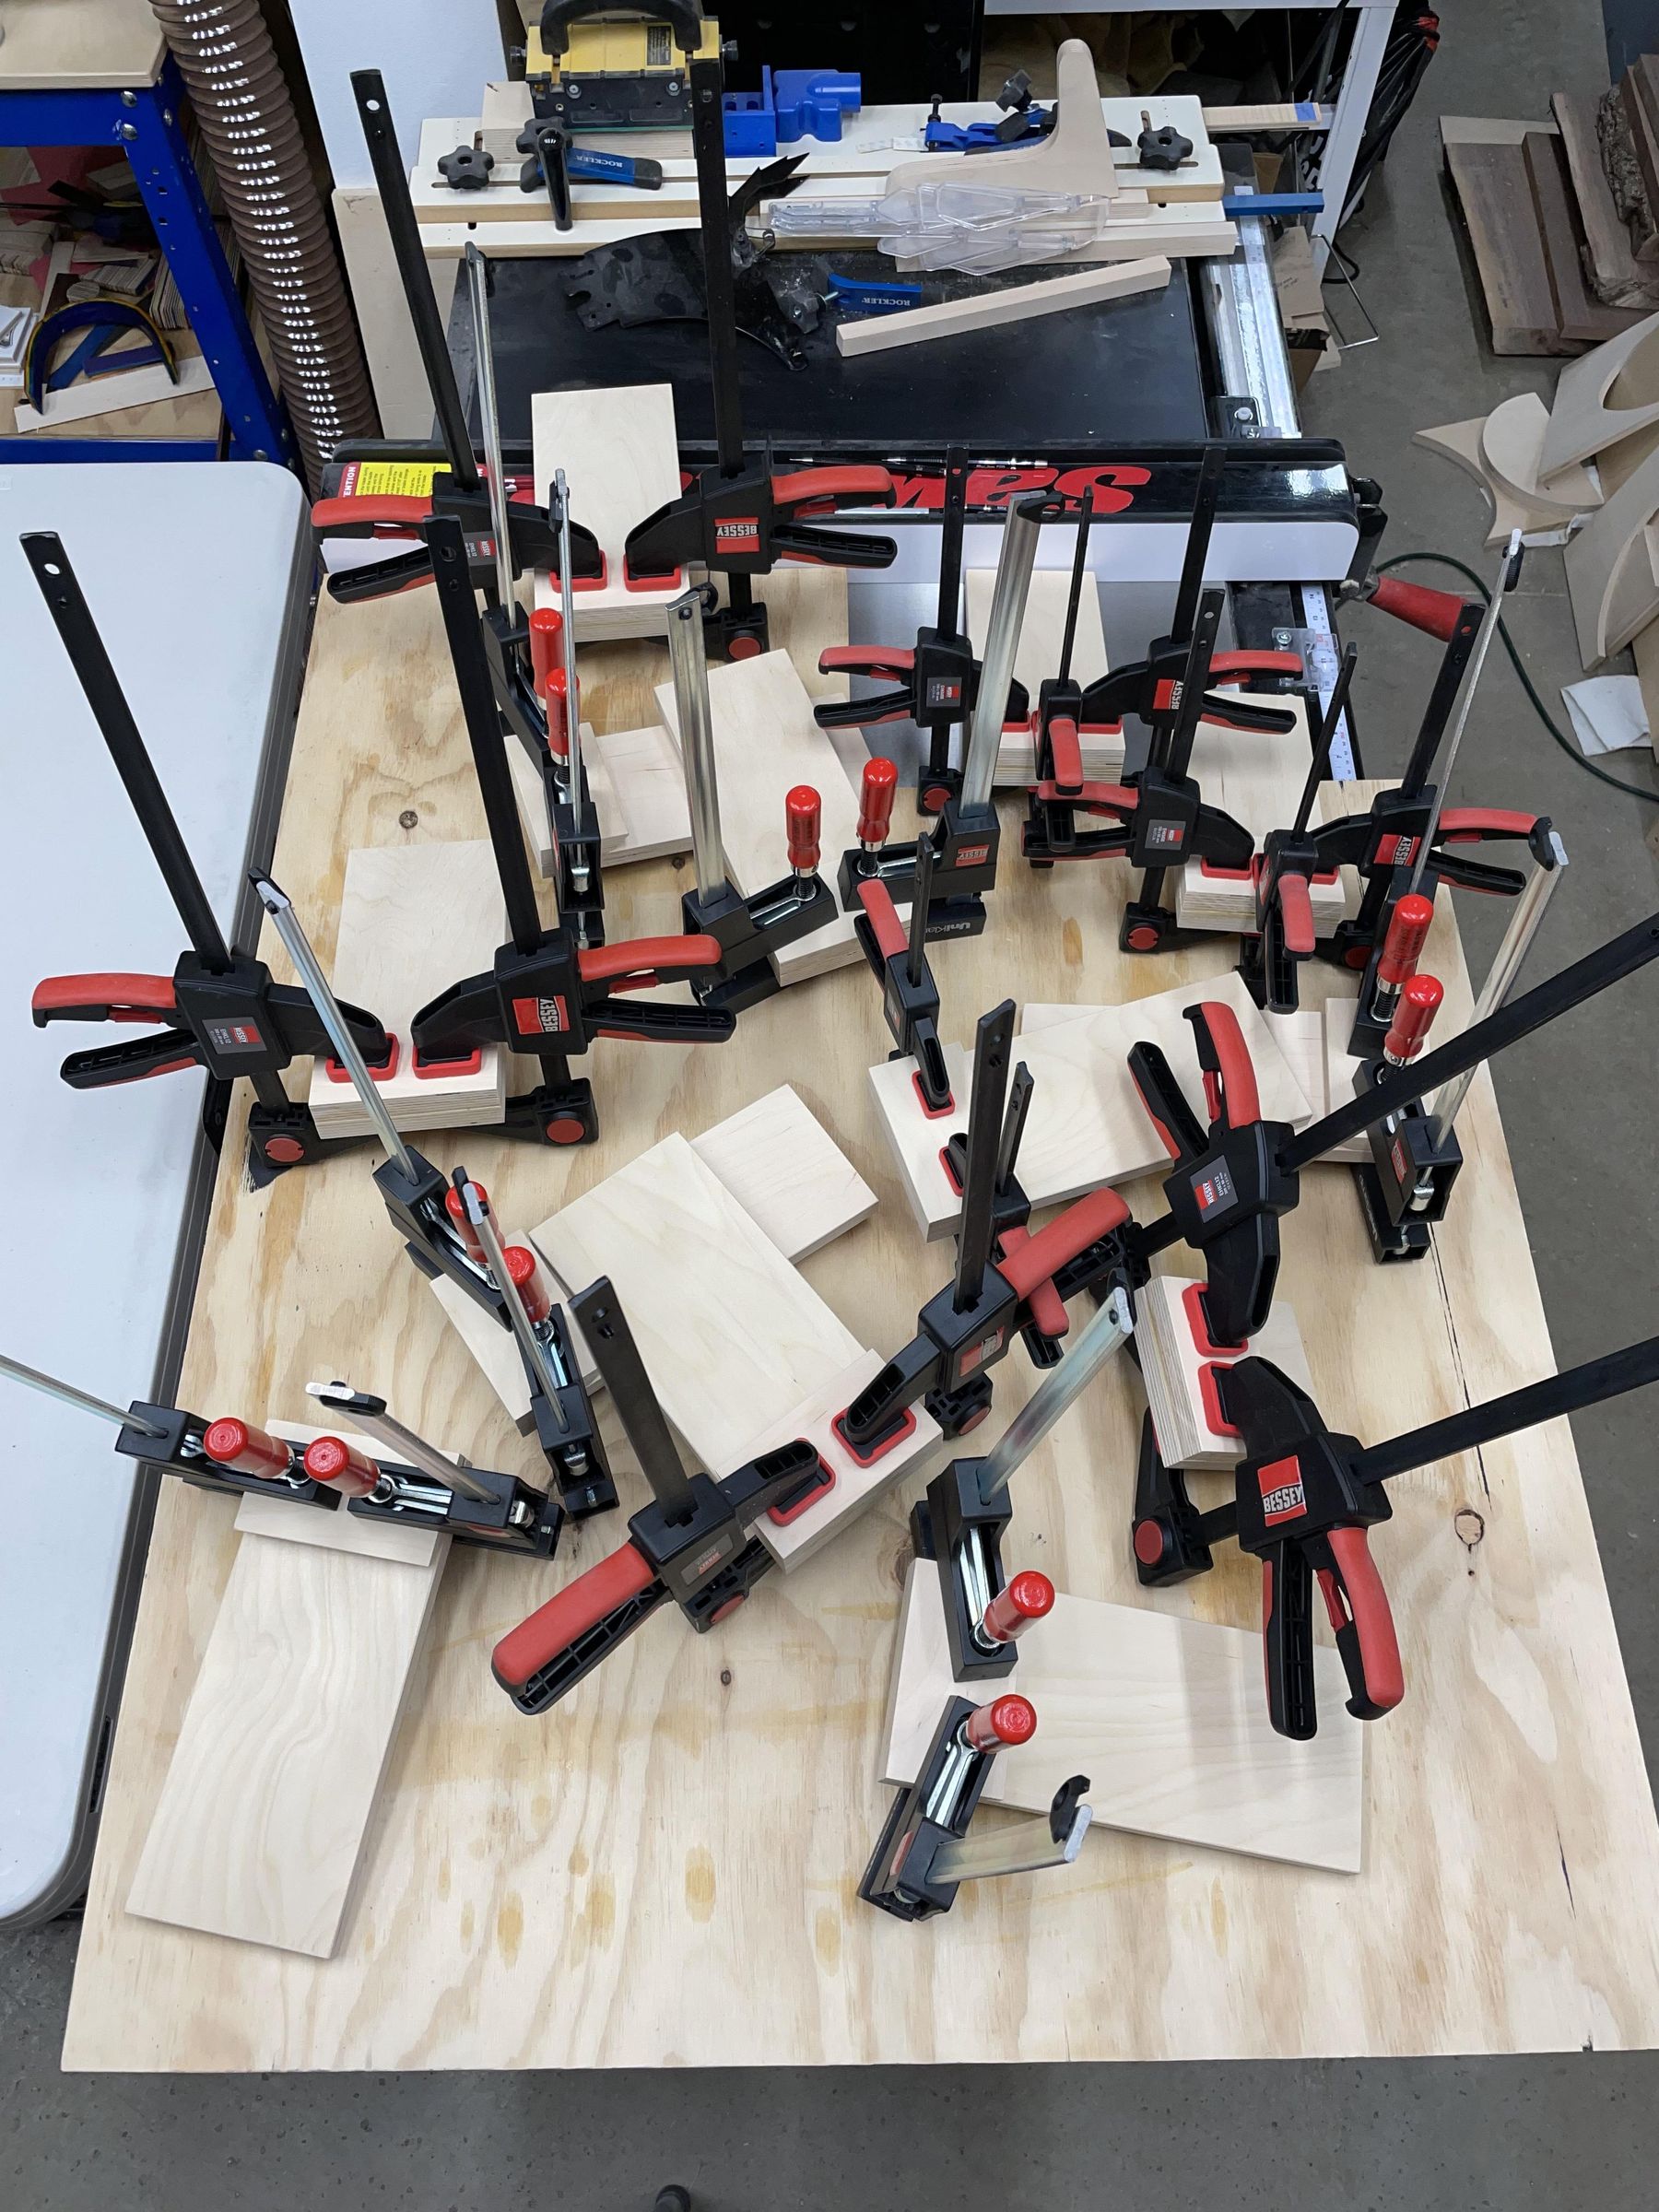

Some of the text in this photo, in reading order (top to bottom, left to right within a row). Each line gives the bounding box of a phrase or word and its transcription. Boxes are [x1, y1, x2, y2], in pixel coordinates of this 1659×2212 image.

[575, 155, 623, 168] ROCKLER
[862, 297, 911, 306] ROCKLER
[717, 525, 758, 537] BESSEY
[1171, 680, 1184, 710] BESSEY
[1394, 837, 1412, 865] BESSEY
[539, 998, 559, 1032] BESSEY
[1263, 1486, 1302, 1512] BESSEY
